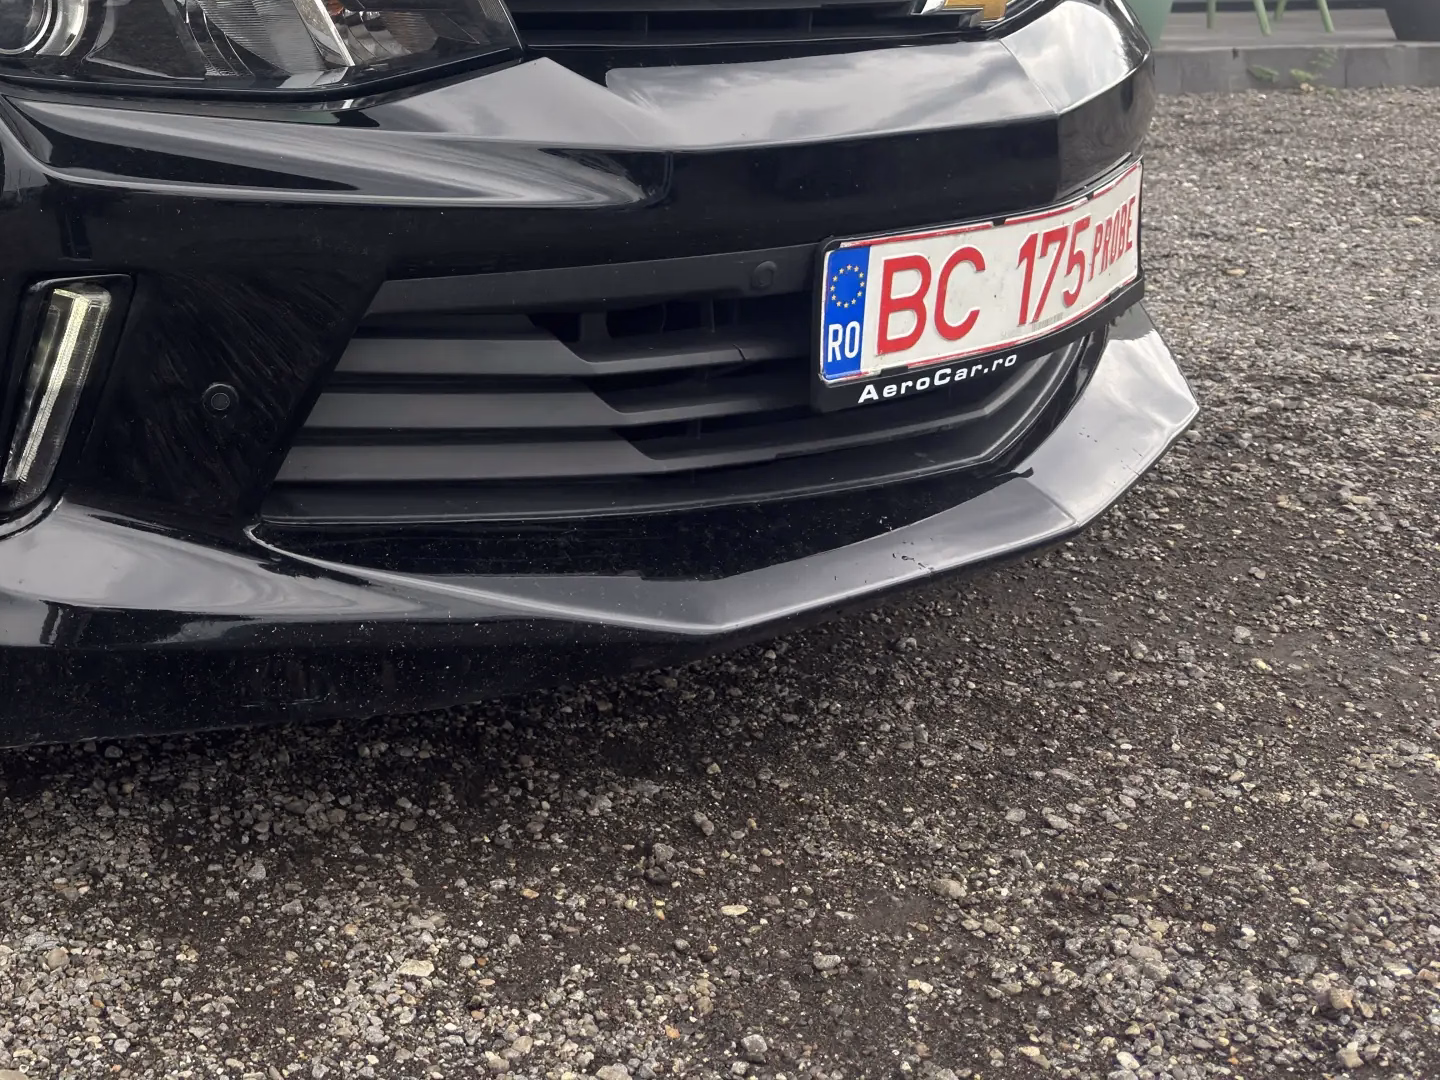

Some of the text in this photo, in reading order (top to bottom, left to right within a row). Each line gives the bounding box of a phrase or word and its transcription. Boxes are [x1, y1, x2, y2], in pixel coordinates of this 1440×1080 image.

[877, 195, 1136, 356] BC 175 PROBE
[827, 321, 861, 363] RO
[858, 354, 1018, 404] AeroCar.ro
